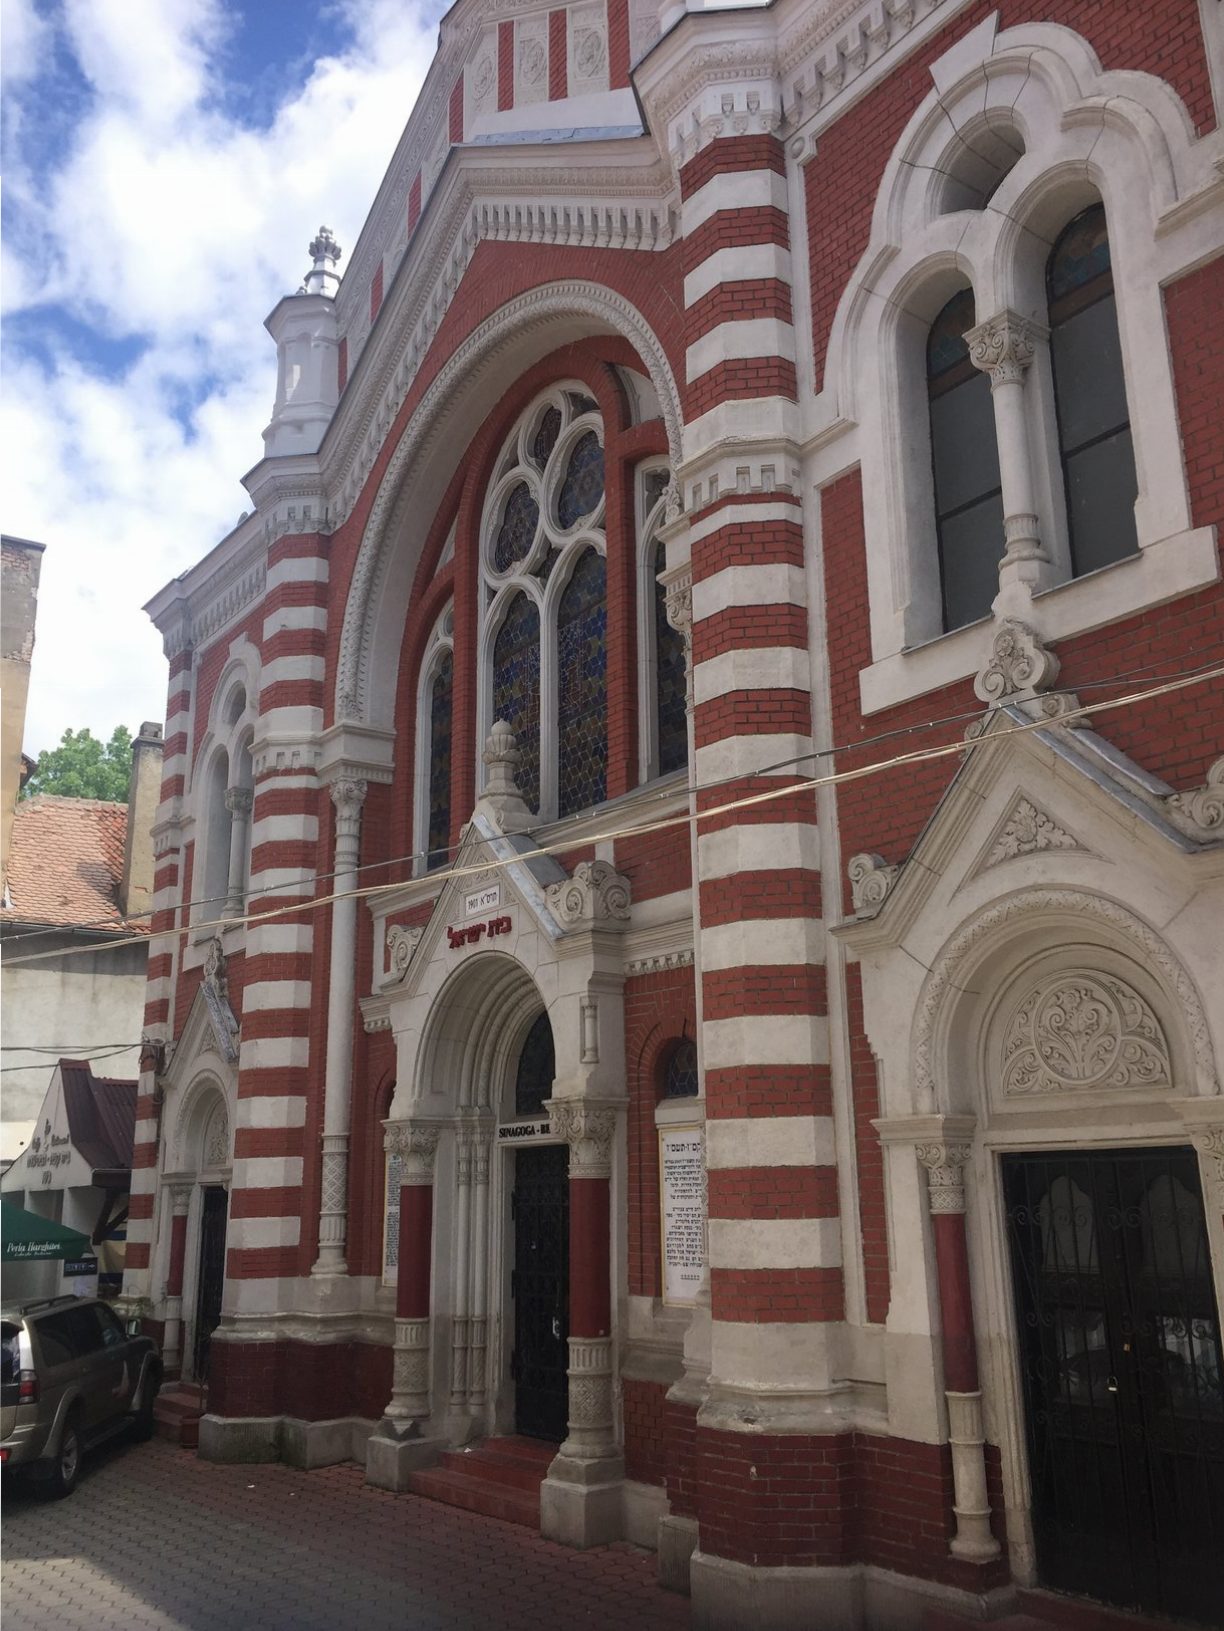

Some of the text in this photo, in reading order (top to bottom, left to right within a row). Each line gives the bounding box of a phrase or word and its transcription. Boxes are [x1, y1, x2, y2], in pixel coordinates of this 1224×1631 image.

[447, 916, 512, 949] בית ישראל
[499, 1125, 535, 1138] SINAGOGA
[541, 1124, 550, 1134] BE
[7, 1242, 26, 1253] Perla
